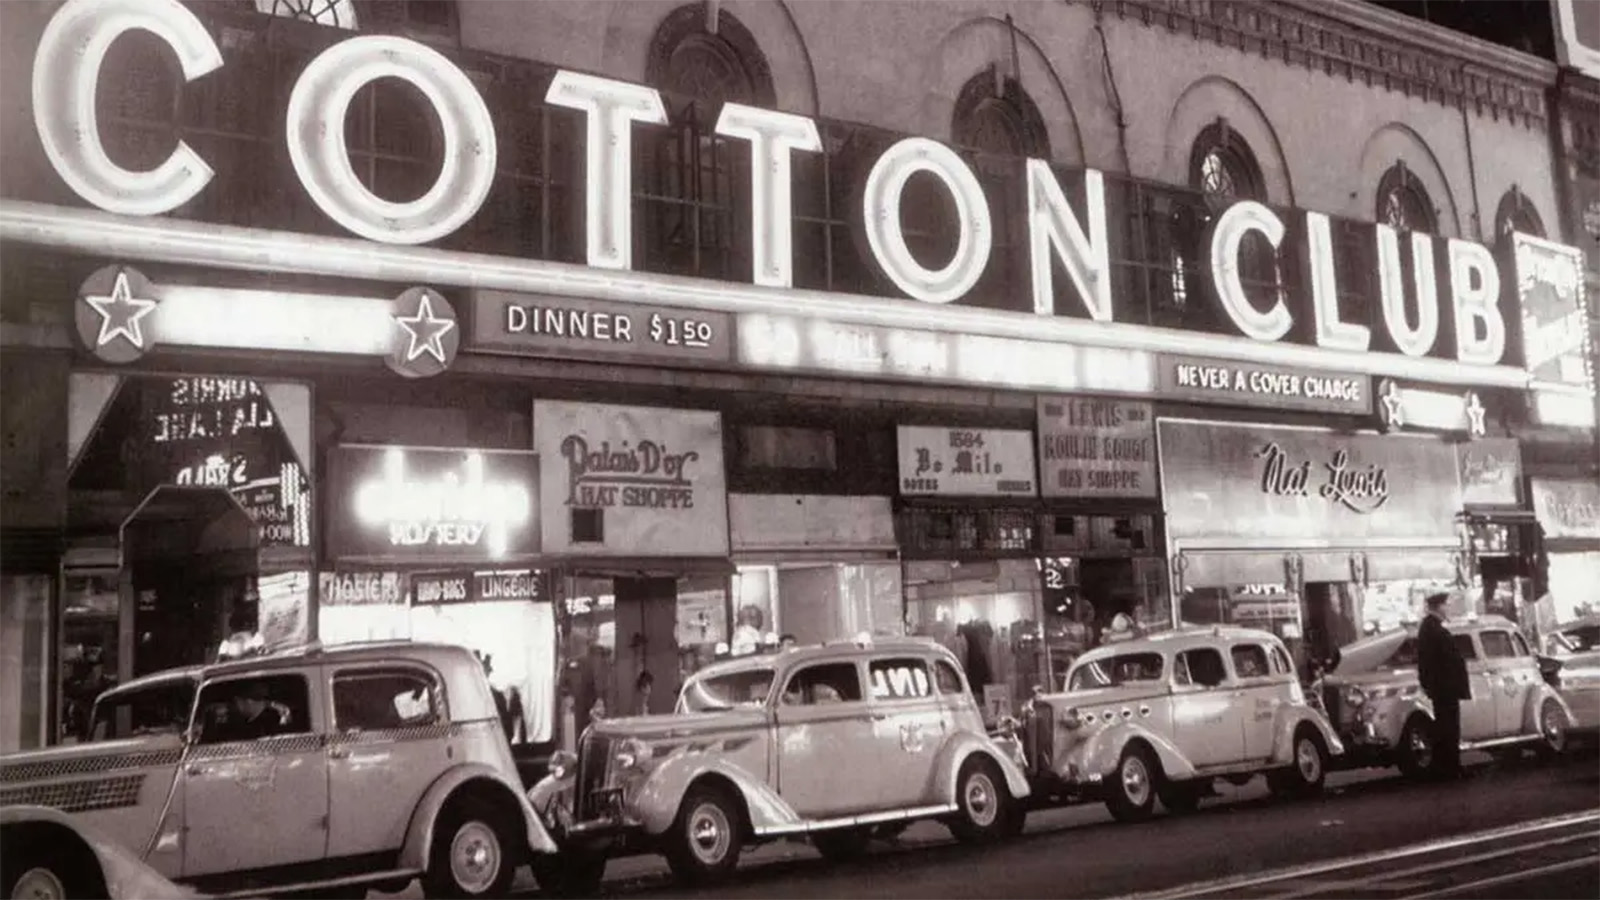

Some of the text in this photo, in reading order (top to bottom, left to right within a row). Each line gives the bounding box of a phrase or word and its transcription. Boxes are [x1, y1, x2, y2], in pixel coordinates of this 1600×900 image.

[31, 0, 1505, 364] COTTON CLUB
[507, 305, 631, 341] DINNER
[1177, 364, 1361, 400] NEVER A COVER CHARGE
[560, 434, 640, 505] Palais
[1253, 441, 1313, 497] Nat
[1318, 449, 1390, 514] Lewis
[580, 486, 694, 509] HAT SHOPPE
[481, 576, 539, 598] LINGERIE
